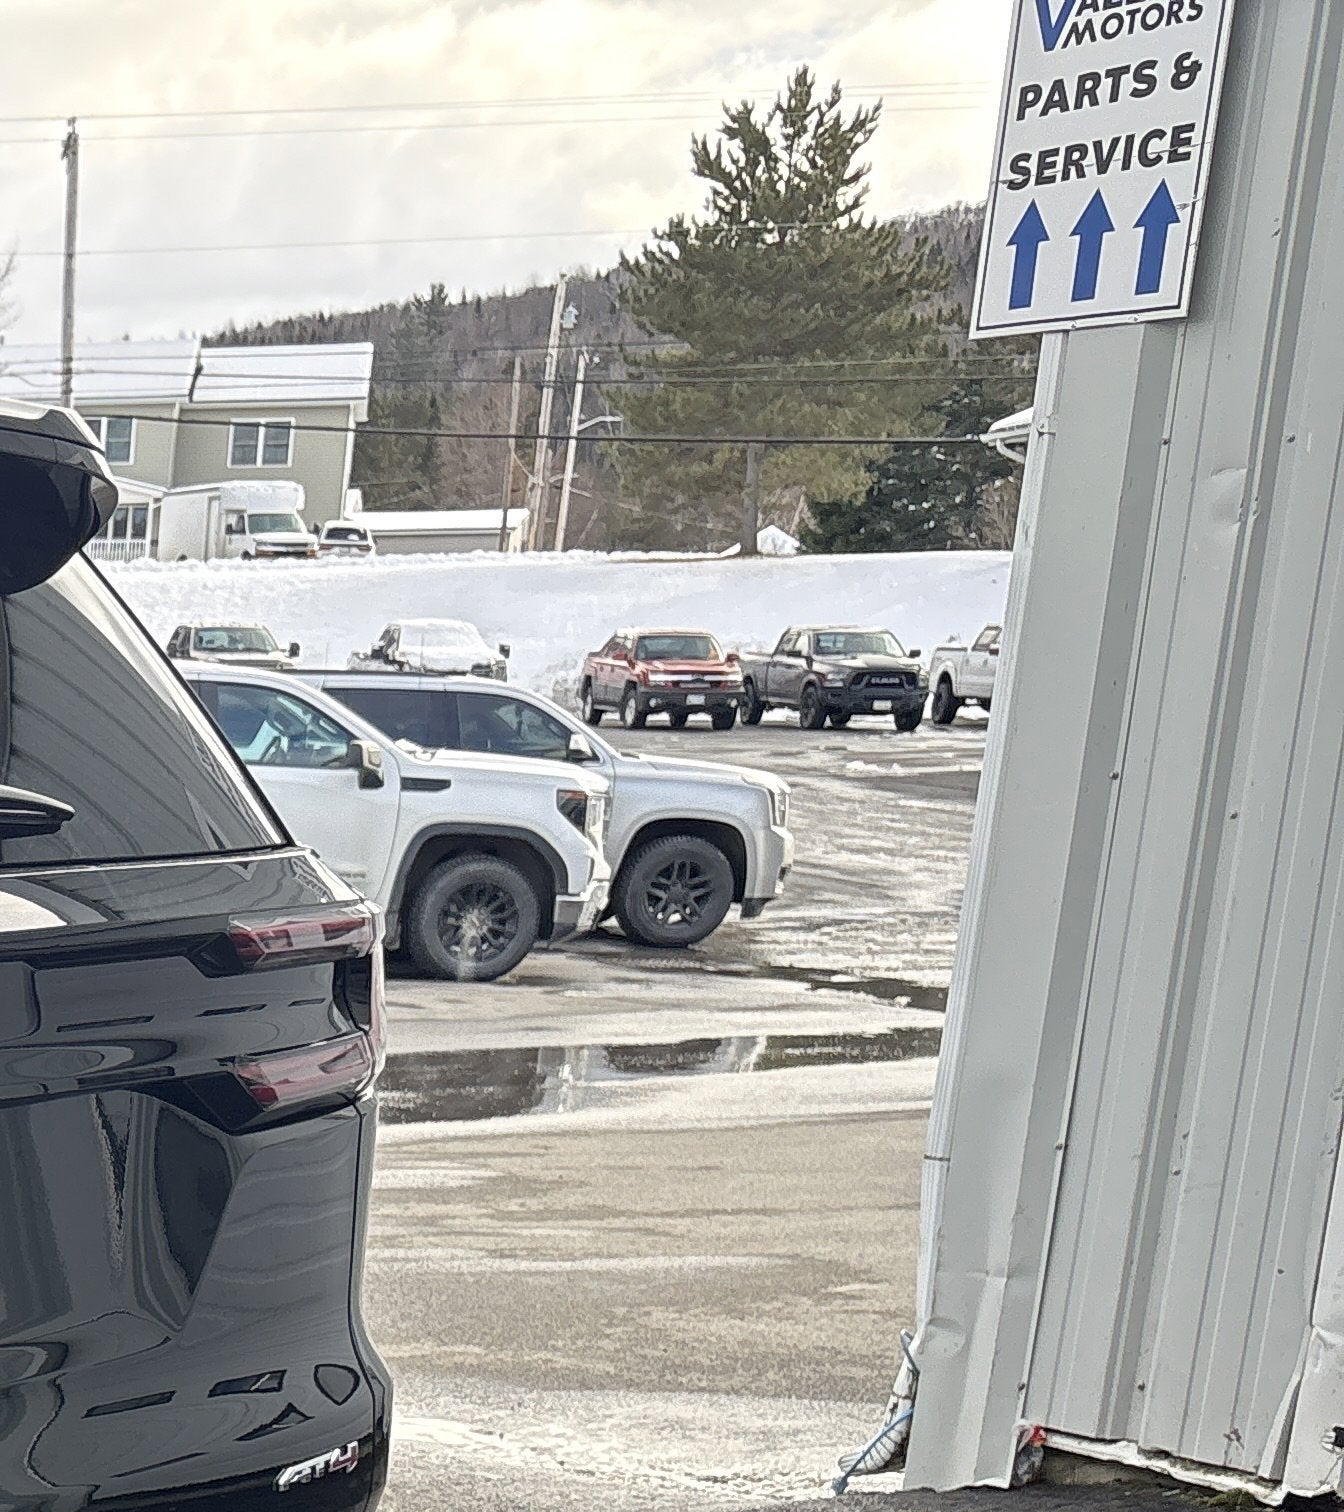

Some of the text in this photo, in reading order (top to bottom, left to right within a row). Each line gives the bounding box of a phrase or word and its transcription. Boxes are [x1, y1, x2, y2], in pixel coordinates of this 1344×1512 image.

[1061, 0, 1204, 49] MOTORS
[1015, 51, 1203, 122] PARTS &
[1006, 122, 1197, 191] SERVICE
[274, 1440, 360, 1493] AT4
